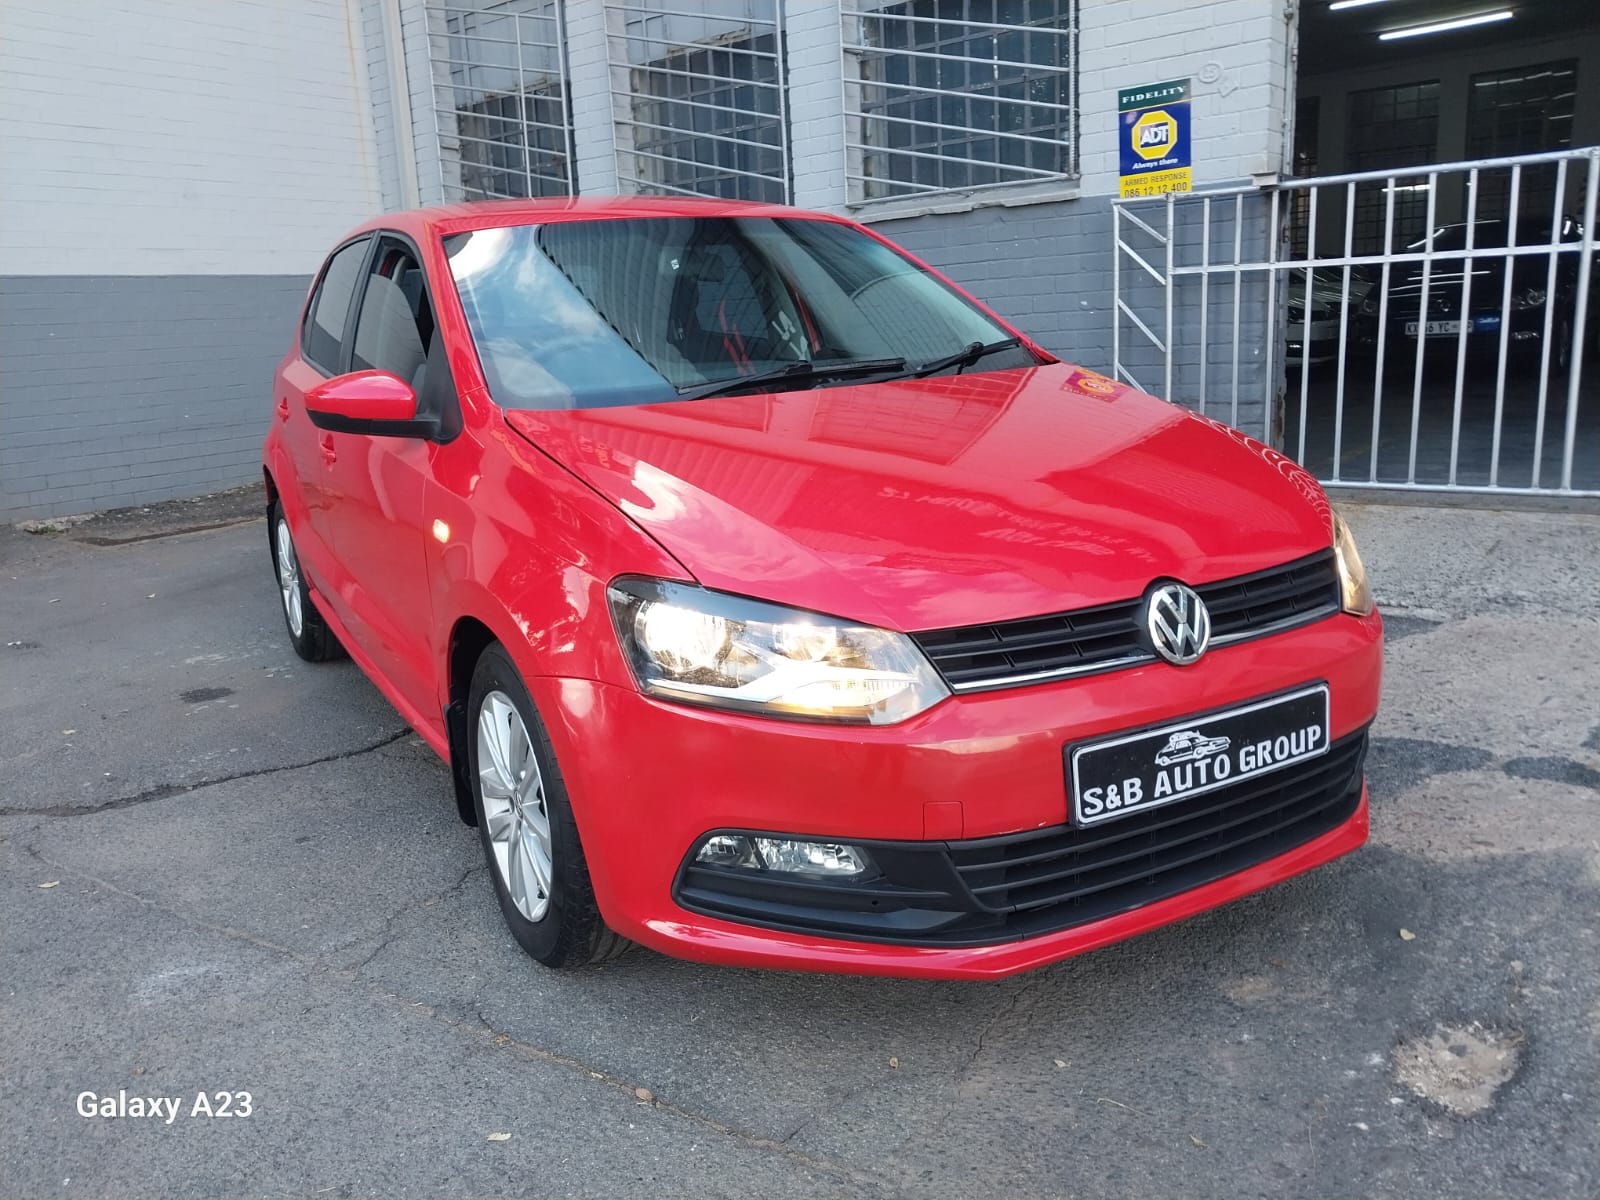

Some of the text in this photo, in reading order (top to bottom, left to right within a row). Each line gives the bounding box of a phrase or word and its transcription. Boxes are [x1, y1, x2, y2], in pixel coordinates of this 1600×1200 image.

[1122, 86, 1185, 103] FIDELITY
[1140, 125, 1168, 145] ADT
[1132, 158, 1178, 169] Always there
[1125, 172, 1187, 186] ARMED RESPONSE
[1124, 182, 1188, 198] 086 12 12 400
[1083, 724, 1322, 815] S&B AUTO GROUP
